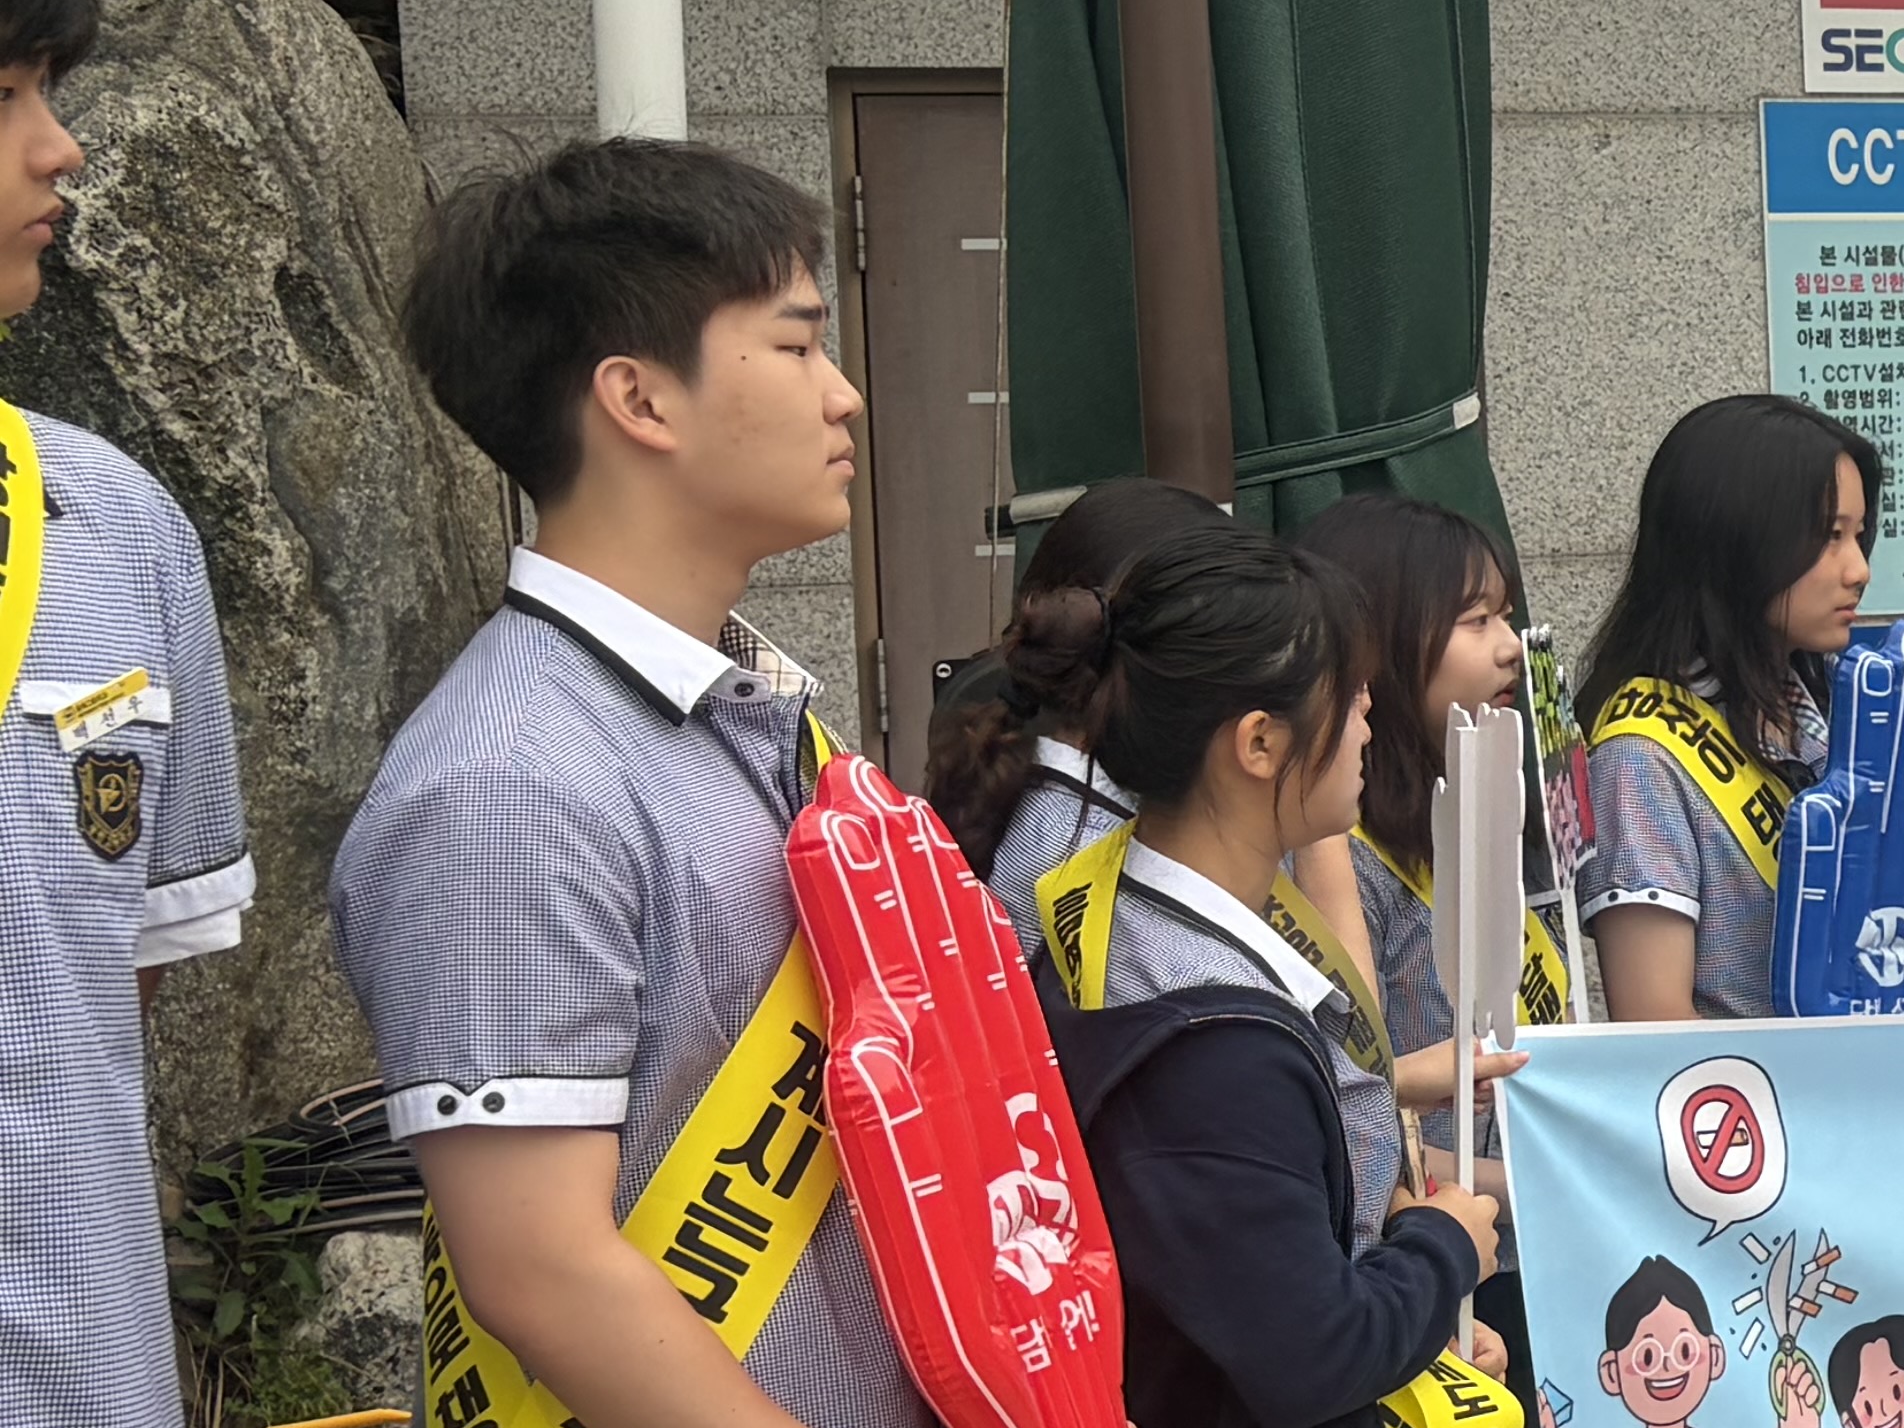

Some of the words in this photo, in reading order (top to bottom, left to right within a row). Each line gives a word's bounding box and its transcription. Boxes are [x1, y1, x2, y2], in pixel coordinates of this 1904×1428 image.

[1819, 245, 1837, 267] 본
[1795, 273, 1865, 295] 침입으로
[1872, 272, 1904, 294] 인한
[1796, 300, 1813, 323] 본
[1820, 299, 1874, 322] 시설과
[1797, 327, 1832, 349] 아래
[1799, 365, 1816, 385] 1.
[1607, 688, 1745, 783] 당신이
